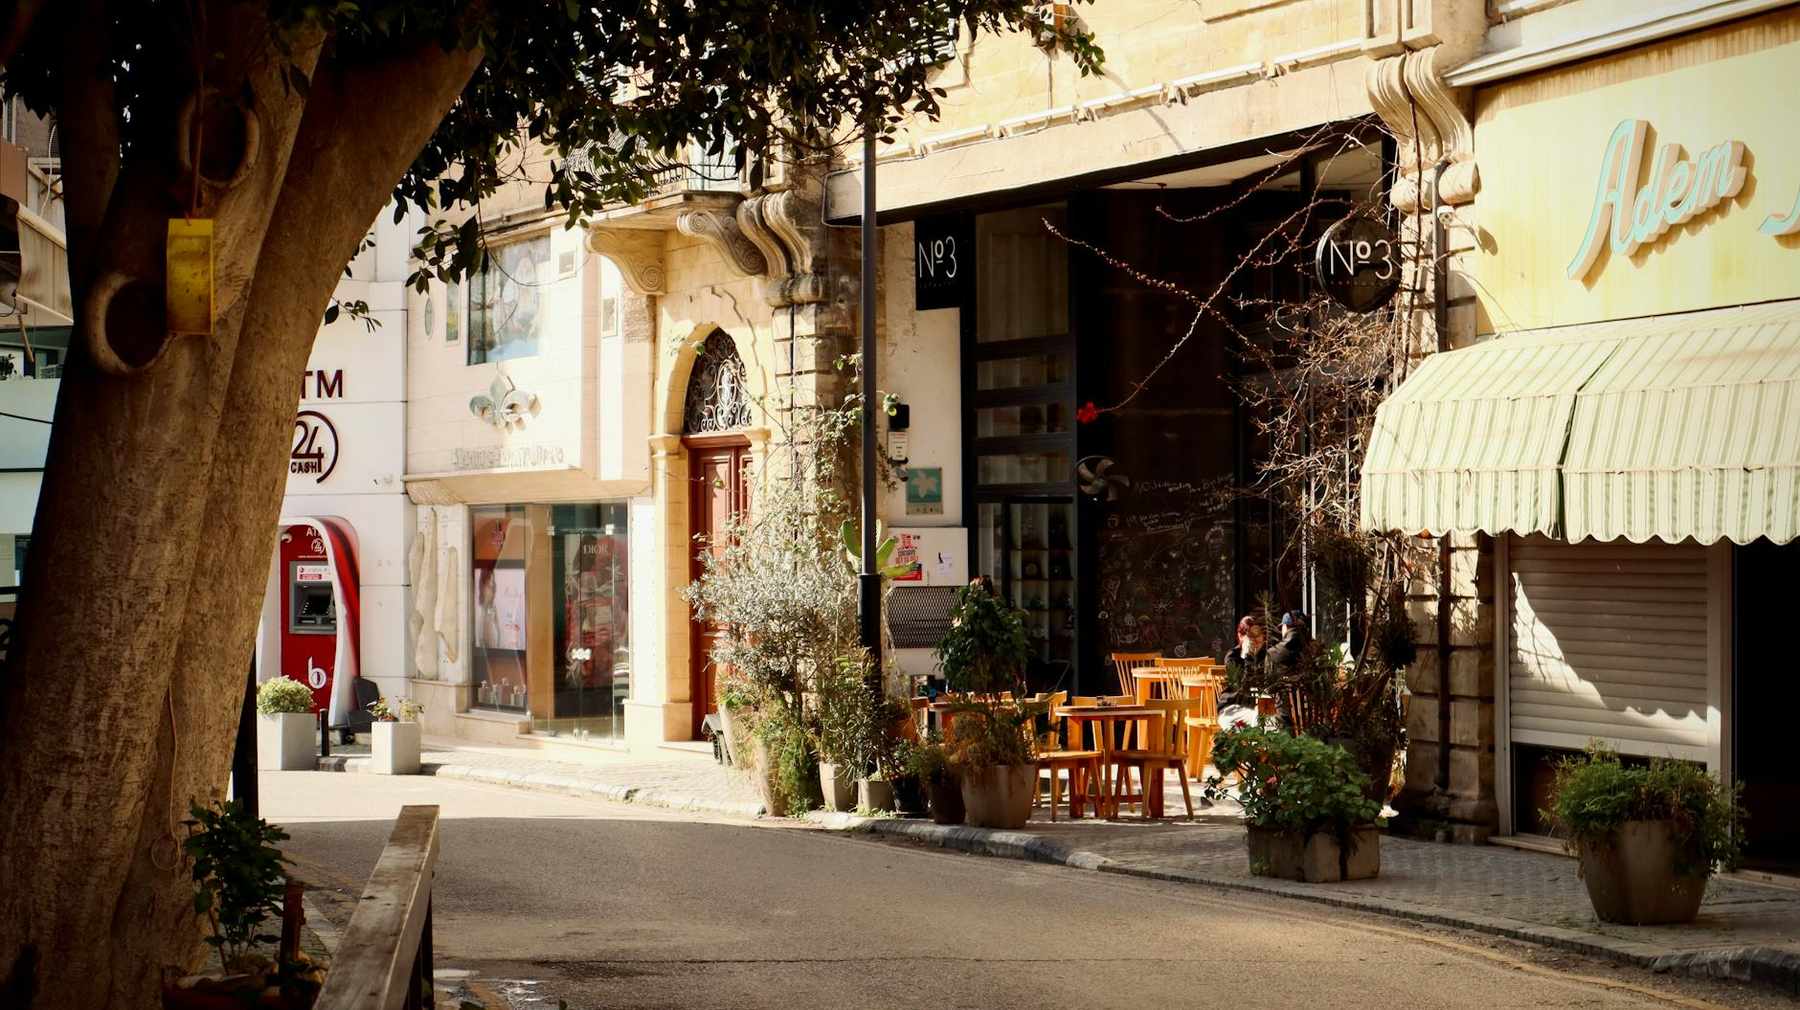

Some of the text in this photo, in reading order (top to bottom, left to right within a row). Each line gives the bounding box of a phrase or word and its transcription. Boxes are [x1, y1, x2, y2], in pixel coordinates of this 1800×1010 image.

[1566, 118, 1747, 280] Adem
[299, 370, 343, 399] TM
[291, 420, 324, 472] 24
[290, 461, 318, 473] CASH
[306, 527, 321, 537] AT
